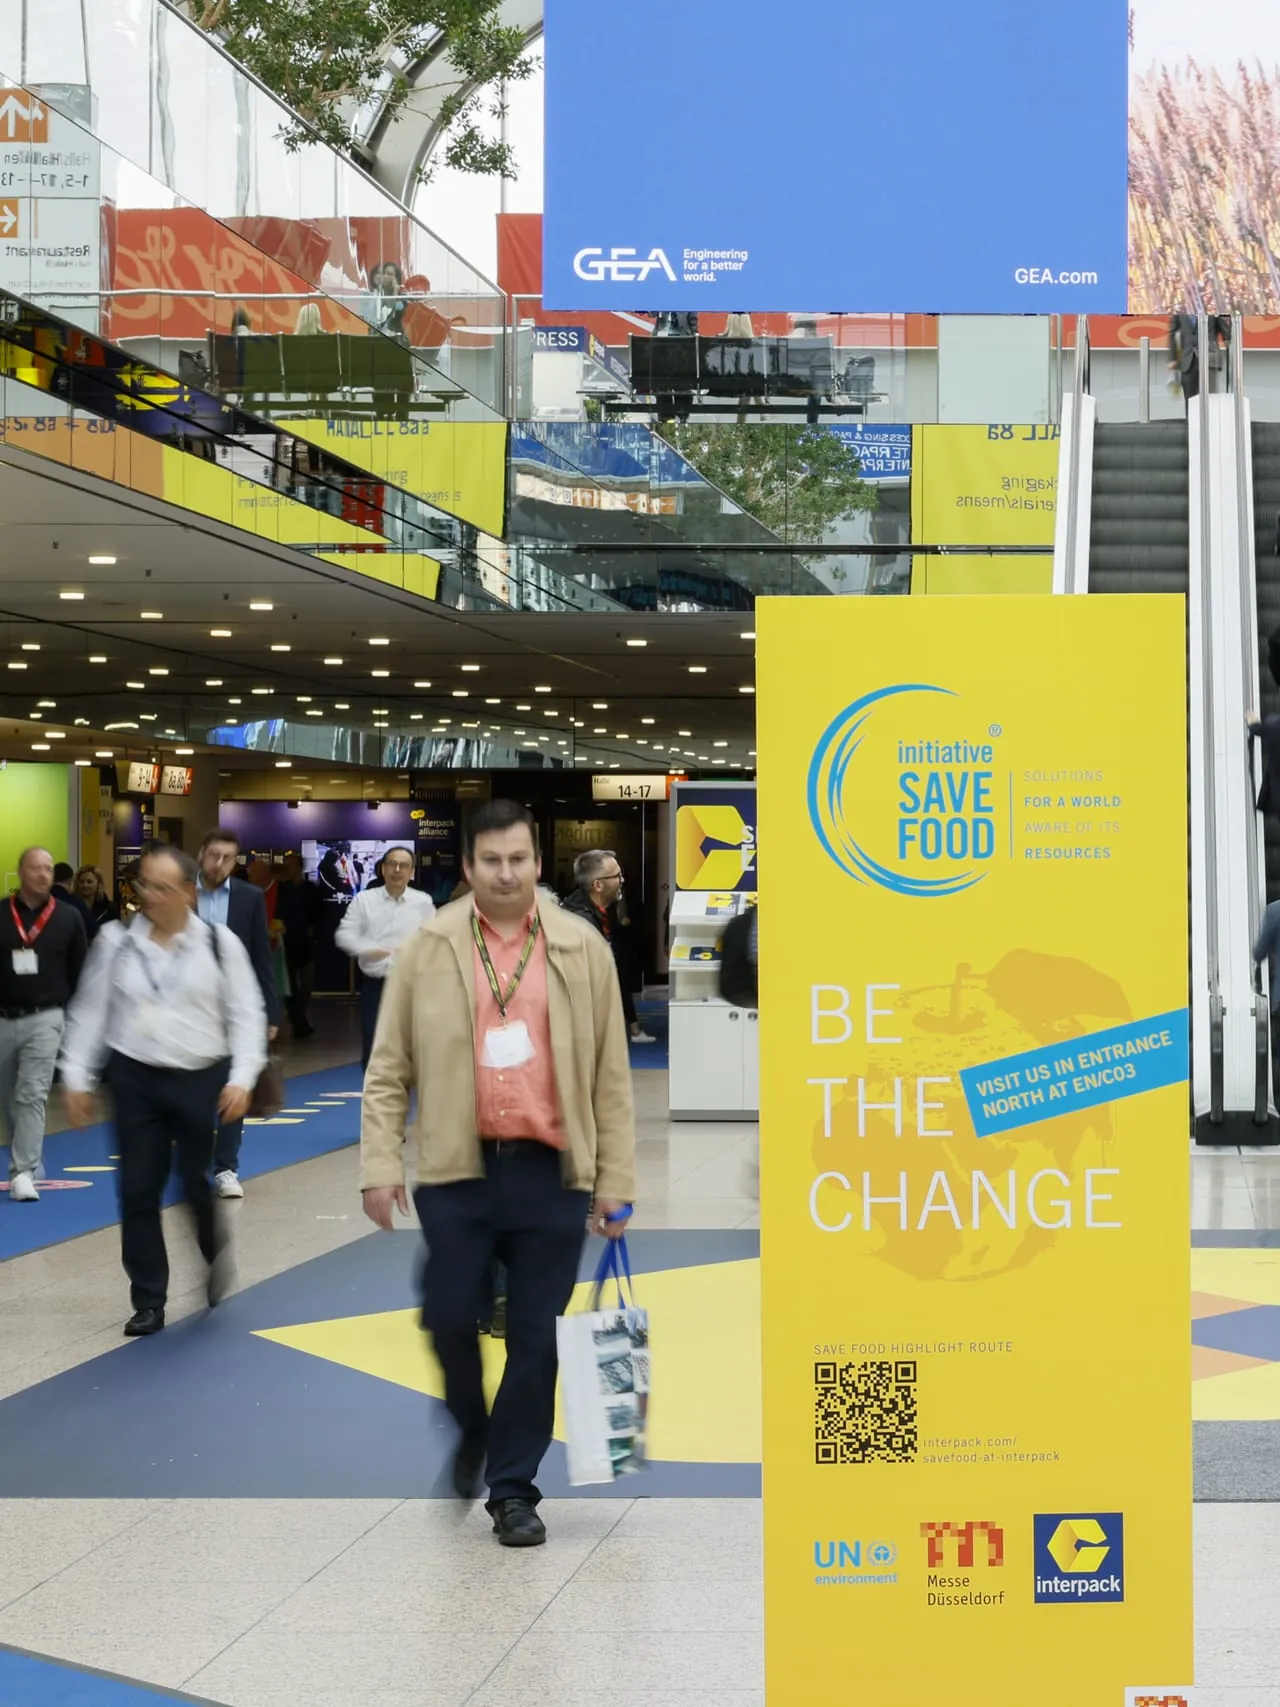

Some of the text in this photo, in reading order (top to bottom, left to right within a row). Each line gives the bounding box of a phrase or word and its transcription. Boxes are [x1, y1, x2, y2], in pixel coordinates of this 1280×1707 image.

[683, 249, 748, 260] Engineering
[573, 247, 677, 281] GEA
[683, 260, 744, 271] for a better
[683, 272, 717, 282] world.
[1015, 268, 1098, 284] GEA.com
[533, 332, 578, 346] RESS
[898, 740, 993, 763] initiative
[1023, 770, 1103, 783] SOLUTIONS
[618, 785, 651, 798] 14-17
[899, 771, 994, 814] SAVE
[1024, 796, 1121, 807] FOR A WORLD
[419, 819, 455, 828] interpack
[1024, 821, 1120, 833] AWARE OF ITS
[419, 828, 449, 836] alliance
[898, 817, 994, 860] FOOD
[1024, 847, 1111, 859] RESOURCES
[810, 983, 903, 1044] BE
[976, 1030, 1173, 1097] VISIT US IN ENTRANCE
[982, 1063, 1137, 1119] NORTH AT EN/C03
[806, 1077, 953, 1138] THE
[809, 1168, 1122, 1232] CHANGE
[814, 1342, 1013, 1355] SAVE FOOD HIGHLIGHT ROUTE
[923, 1436, 1017, 1449] interpack.com/
[923, 1451, 1060, 1464] savefood-at-interpack
[814, 1541, 861, 1568] UN
[815, 1572, 898, 1585] environment
[927, 1574, 970, 1588] Messe
[1036, 1575, 1120, 1596] interpack
[927, 1591, 1005, 1606] Düsseldorf
